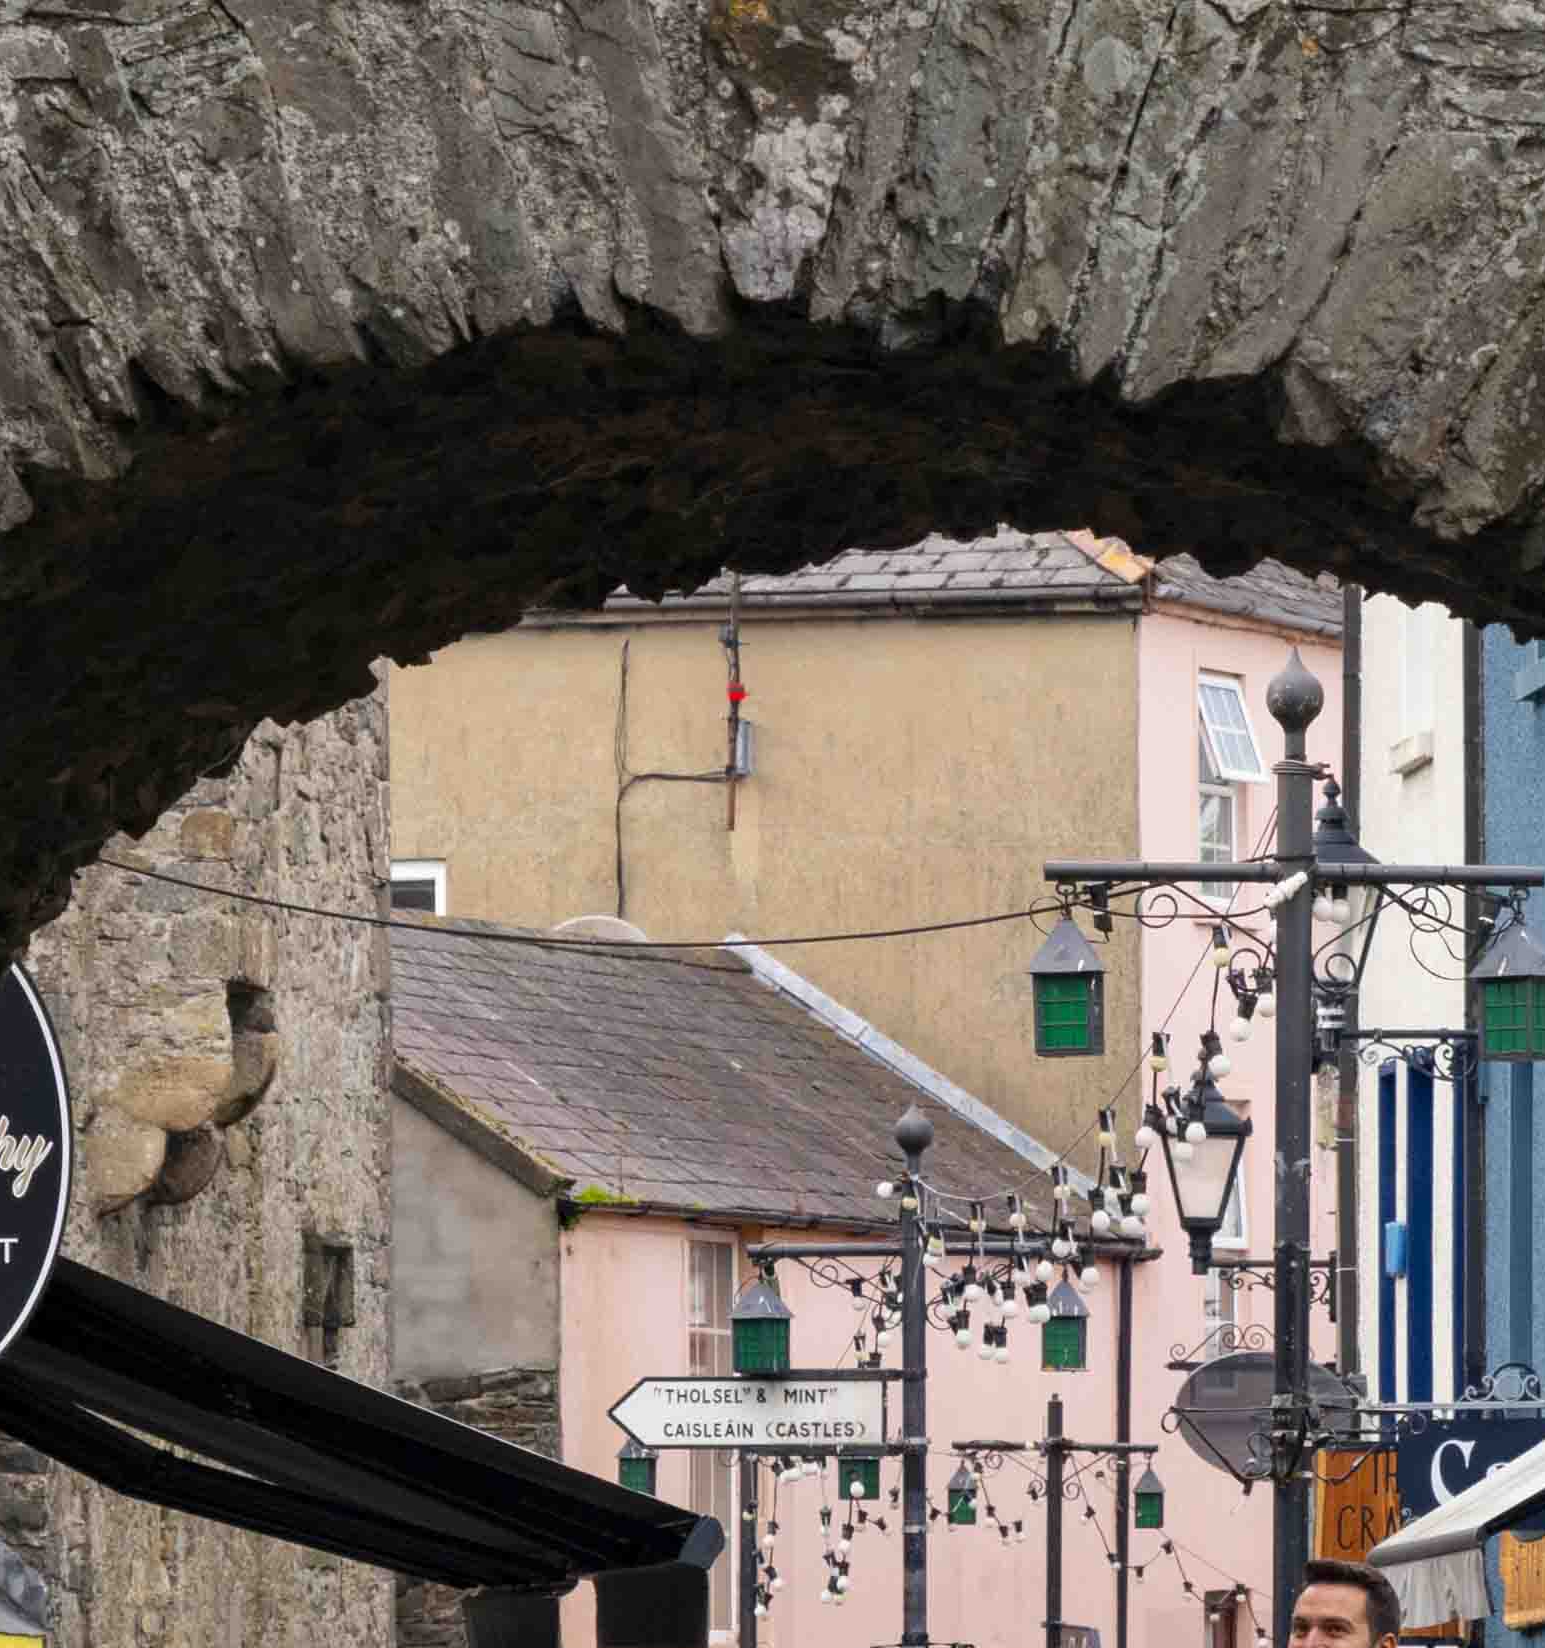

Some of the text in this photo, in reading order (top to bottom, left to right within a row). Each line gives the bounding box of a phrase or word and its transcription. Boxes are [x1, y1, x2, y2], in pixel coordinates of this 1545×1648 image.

[756, 1388, 767, 1404] &
[765, 1422, 866, 1439] (CASTLES)
[1337, 1504, 1399, 1551] CRA
